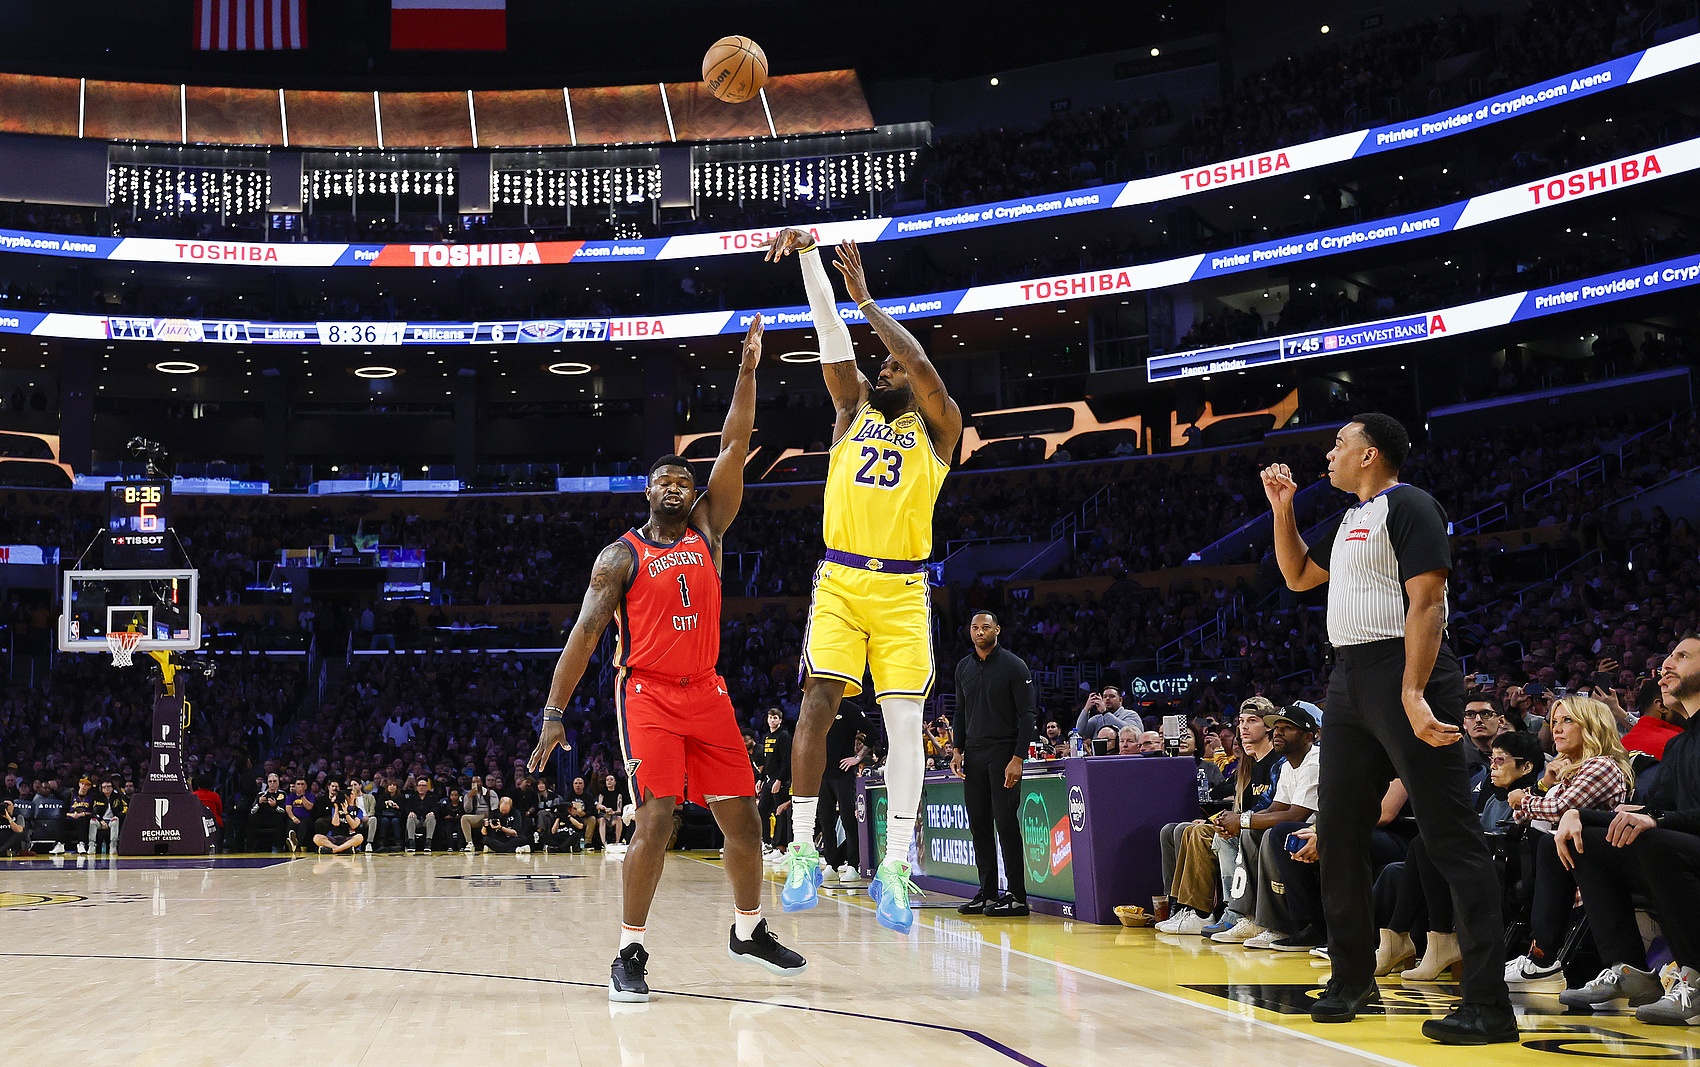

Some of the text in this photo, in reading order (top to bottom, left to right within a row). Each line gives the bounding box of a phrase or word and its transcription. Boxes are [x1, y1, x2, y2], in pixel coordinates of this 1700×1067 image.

[1376, 70, 1612, 146] Printer Provider of Crypto.com Arena
[1180, 152, 1291, 190] TOSHIBA
[1528, 154, 1662, 205] TOSHIBA
[897, 194, 1100, 233] Printer Provider of Crypto.com Arena
[61, 240, 96, 253] Arena
[612, 244, 645, 256] Arena
[719, 228, 821, 250] TOSHA
[1212, 216, 1440, 270] Printer Provider of Crypto.com Arena
[175, 242, 278, 262] TOSHIBA
[409, 242, 541, 266] TOSHIBA
[1020, 271, 1132, 300] TOSHIBA
[1535, 262, 1700, 309] Printer Provider of Cryp
[908, 300, 942, 314] Arena
[213, 324, 238, 340] 10
[264, 328, 306, 340] Lakers
[328, 326, 376, 342] 8:36
[414, 328, 464, 340] Pelicans
[491, 326, 504, 341] 6
[1429, 314, 1446, 334] A
[392, 332, 398, 342] 1
[1288, 338, 1320, 354] 7:45
[850, 420, 918, 450] LAKERS
[854, 446, 904, 490] 23
[124, 486, 161, 503] 8:36
[140, 502, 158, 531] 6
[125, 536, 164, 545] TISSOT
[648, 551, 704, 578] CRESCENT
[676, 573, 691, 608] 1
[672, 612, 698, 631] CITY
[926, 804, 940, 828] THE
[940, 804, 964, 829] GO-TO
[1024, 816, 1048, 856] bibigo
[931, 838, 940, 862] OF
[941, 839, 968, 865] LAKERS
